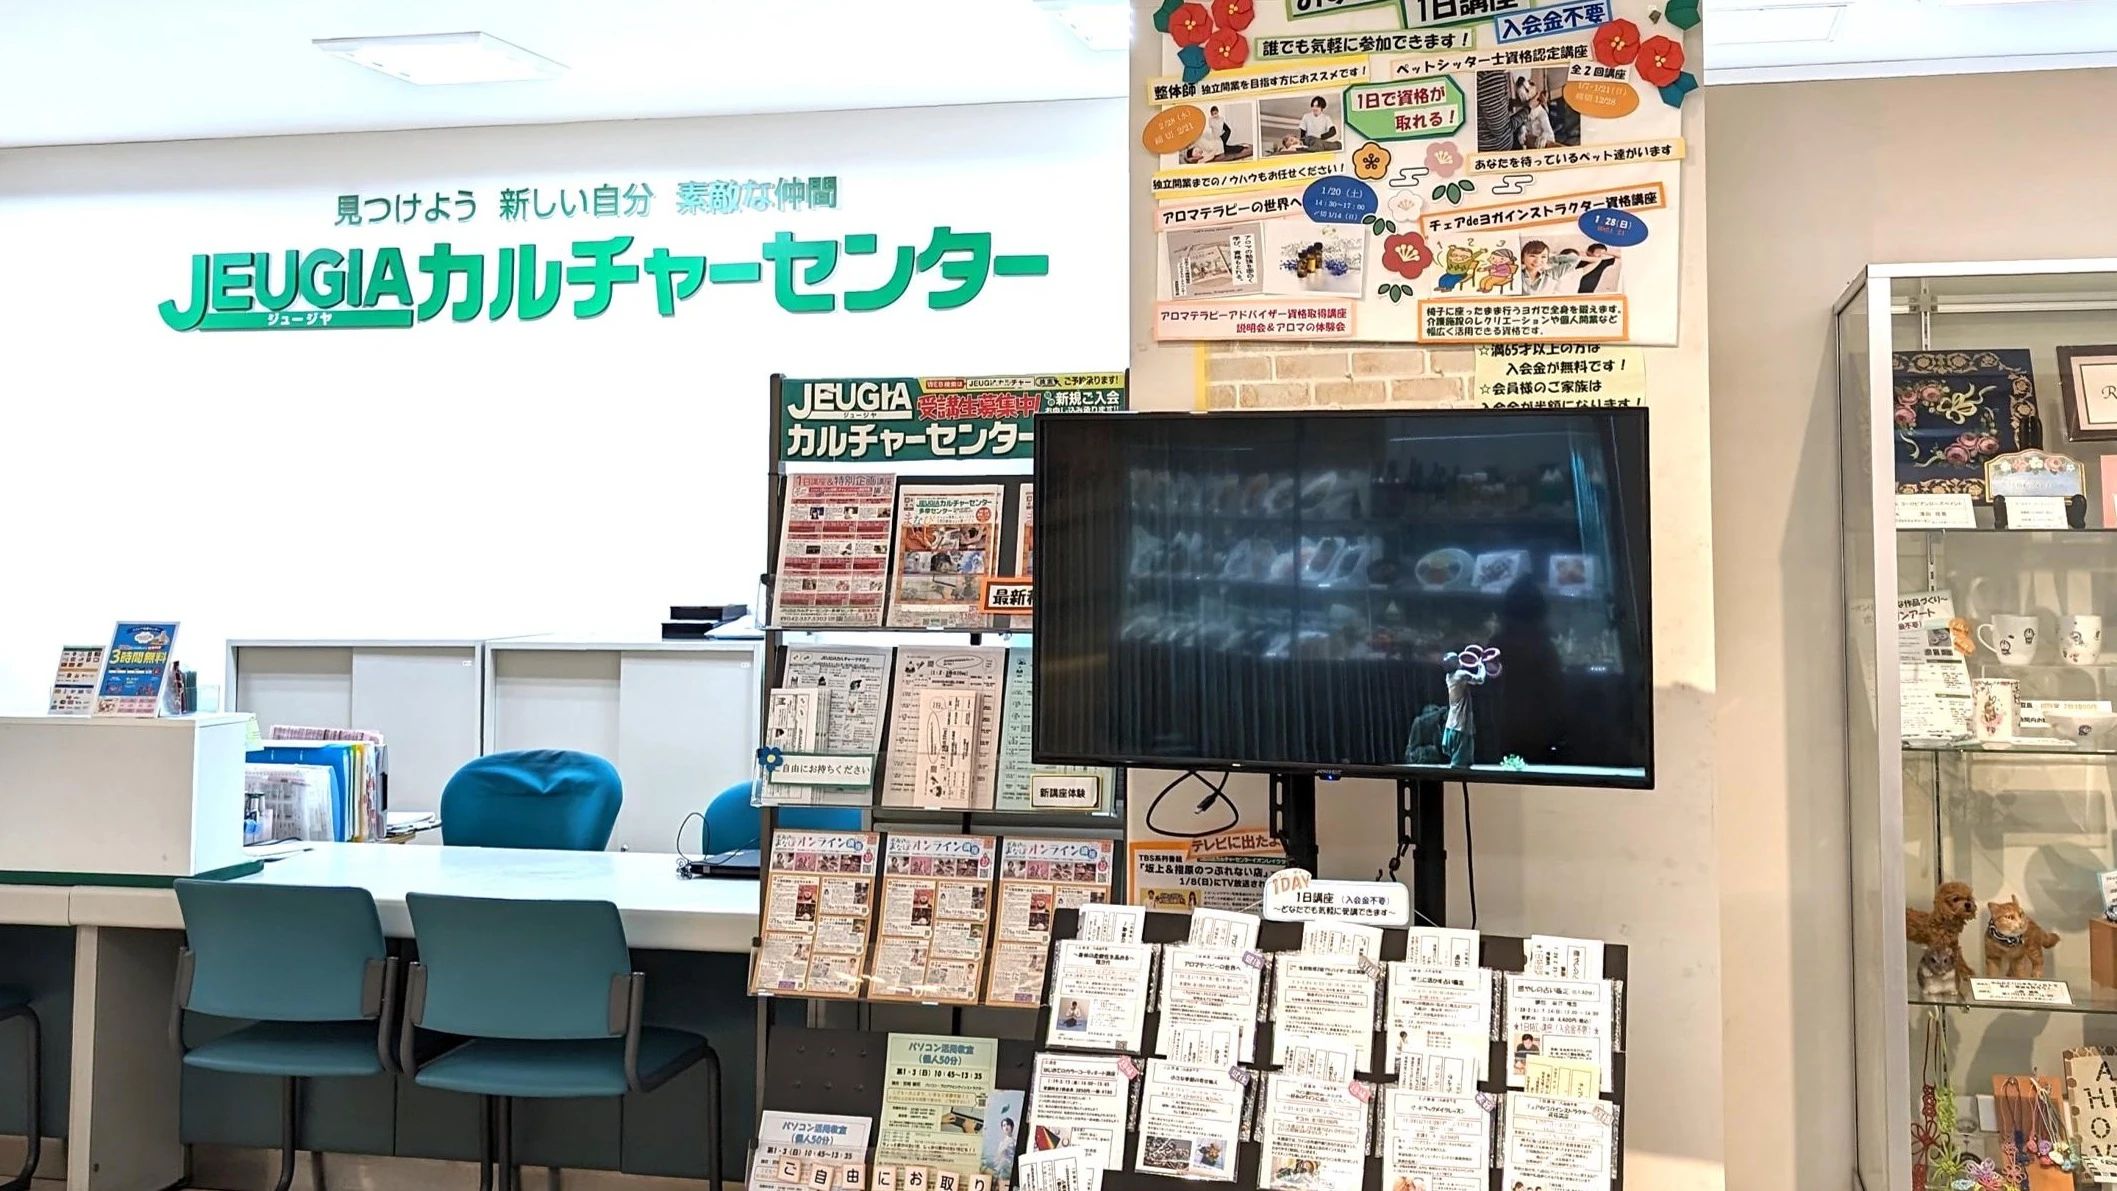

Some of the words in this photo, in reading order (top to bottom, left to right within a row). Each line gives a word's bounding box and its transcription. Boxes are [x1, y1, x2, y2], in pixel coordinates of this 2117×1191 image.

[1503, 6, 1607, 40] 入会金不要
[1262, 32, 1470, 57] 誰でも気軽に参加できます！
[1396, 44, 1588, 75] ペットシッター士資格認定講座
[1154, 84, 1196, 100] 整体師
[1357, 86, 1445, 109] 1日で資格が
[1395, 110, 1455, 131] 取れる！
[1474, 145, 1672, 170] あなたを待っているペット達がいます
[1153, 163, 1345, 190] 独立開業までのノウハウもお任せください！
[335, 192, 478, 226] 見つけよう
[499, 183, 655, 221] 新しい自分
[675, 175, 841, 217] 素敵な仲間
[1162, 197, 1302, 224] アロマテラピーの世界へ
[1160, 308, 1347, 321] アロマテラピーアドバイザー資格取得講座
[1506, 359, 1626, 376] 入会金が無料です！
[788, 383, 913, 419] JEUGIA
[1055, 390, 1120, 406] 新規ご入会
[788, 421, 1034, 457] カルチャーセンター
[1040, 786, 1086, 799] 新講座体験
[1272, 873, 1310, 895] 1DAY
[1296, 892, 1334, 904] 1日講座
[908, 1042, 975, 1055] パソコン活用教室
[781, 1121, 849, 1135] パソコン活用教室
